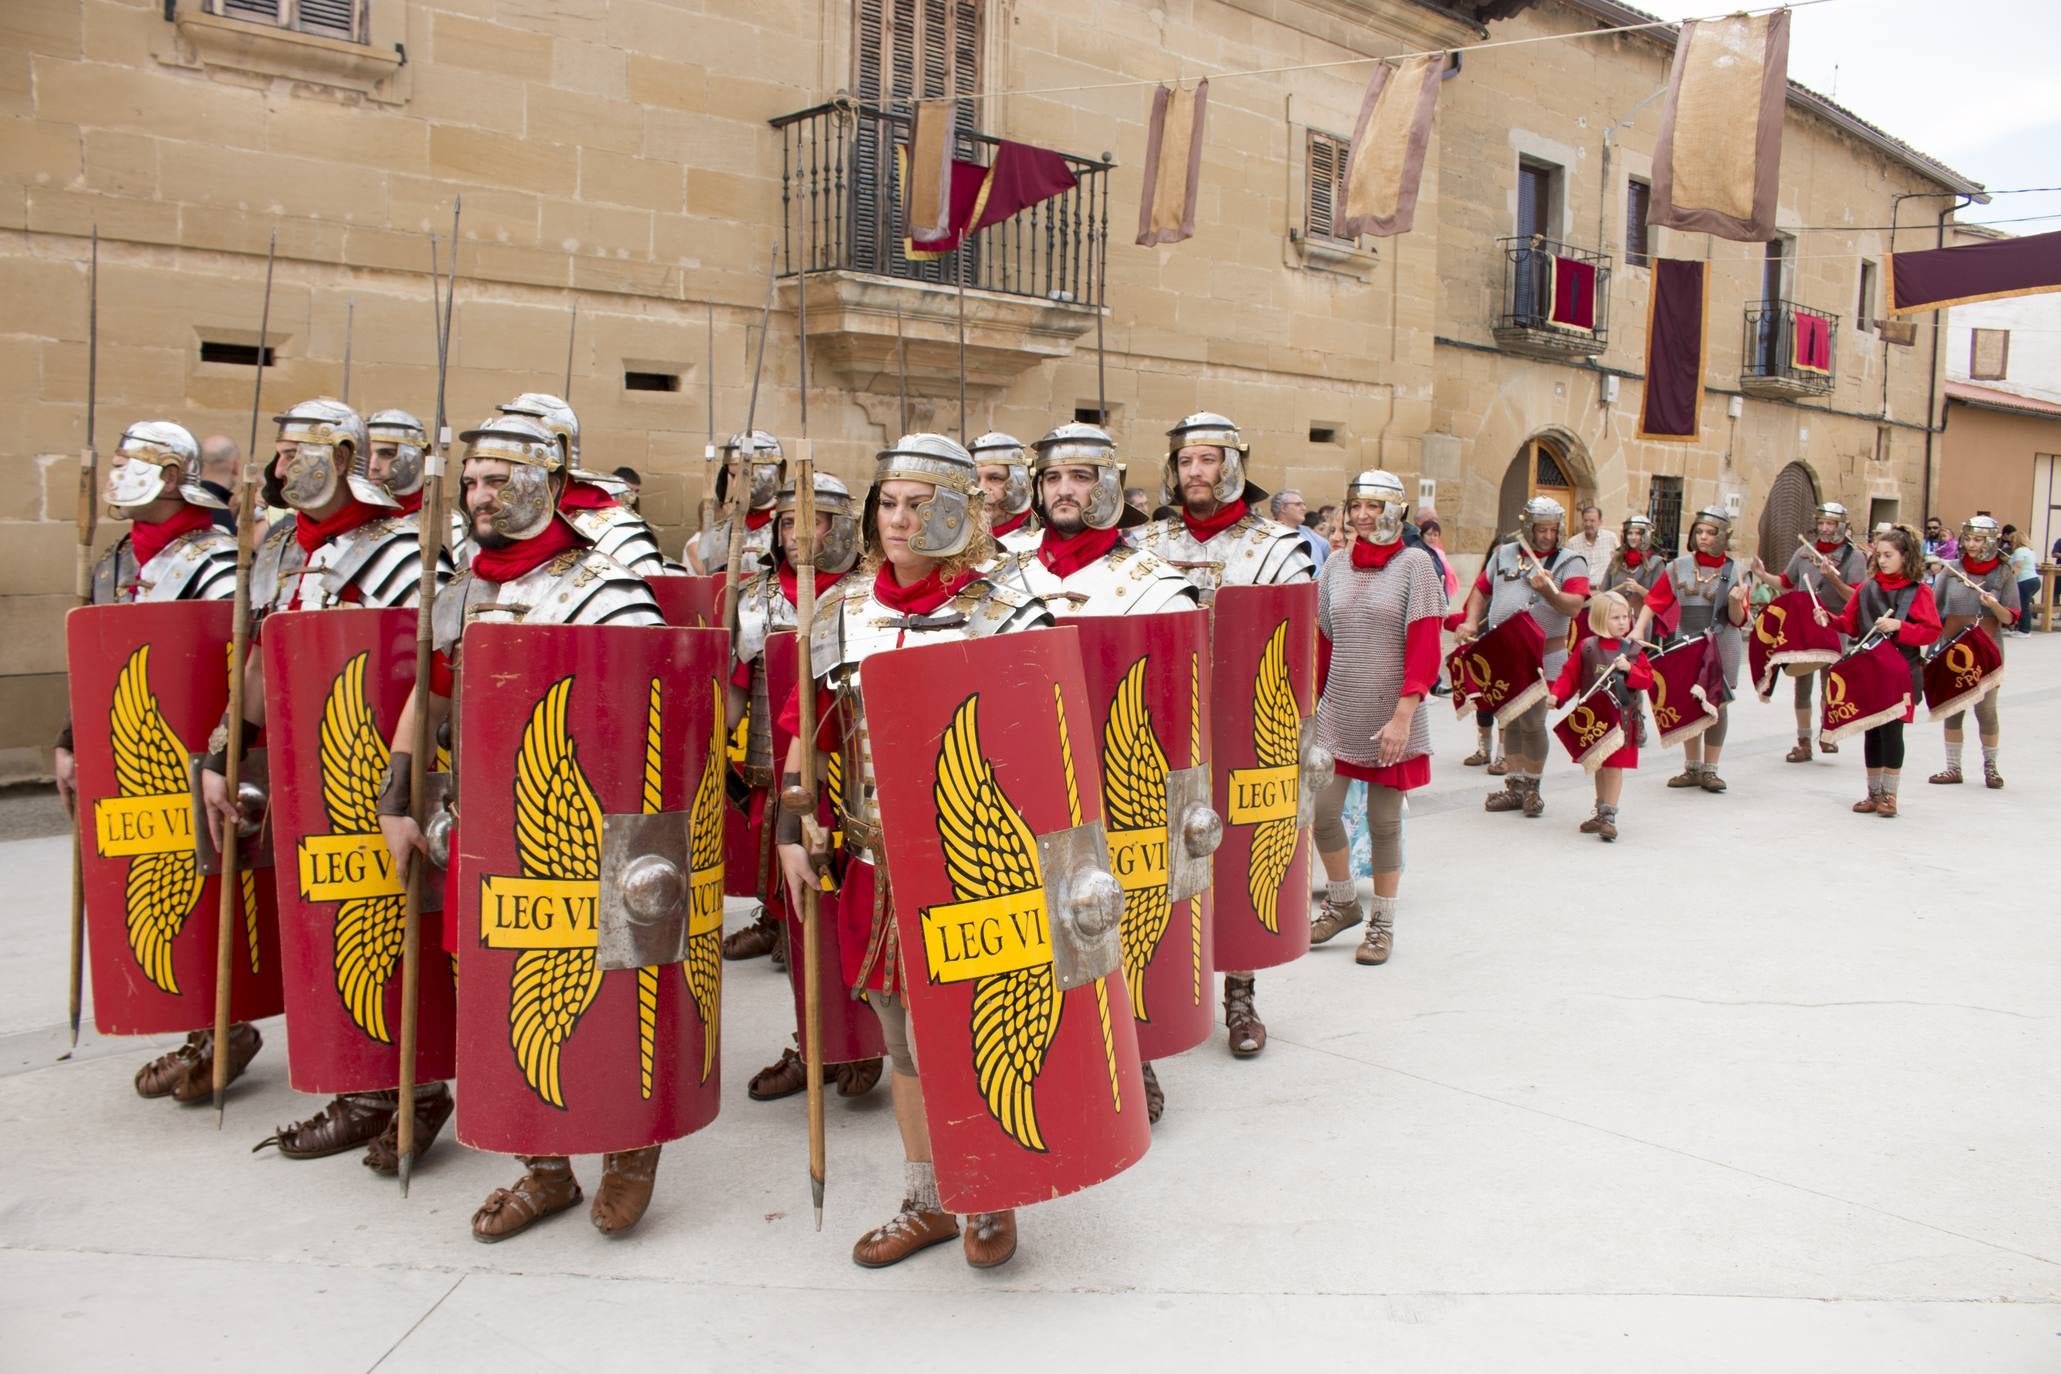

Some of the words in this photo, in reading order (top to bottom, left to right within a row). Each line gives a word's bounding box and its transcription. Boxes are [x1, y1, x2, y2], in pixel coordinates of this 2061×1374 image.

[1827, 702, 1860, 724] SPQR
[1579, 720, 1609, 747] SPQR
[1238, 782, 1276, 809] LEG
[1280, 777, 1297, 804] VI
[106, 810, 155, 842] LEG
[165, 807, 192, 838] VI
[311, 846, 366, 886] LEG
[372, 848, 395, 881] V
[1140, 841, 1166, 873] VI
[494, 895, 554, 930] LEG
[562, 896, 597, 930] VI
[937, 917, 1004, 963] LEG
[1009, 908, 1047, 949] VI
